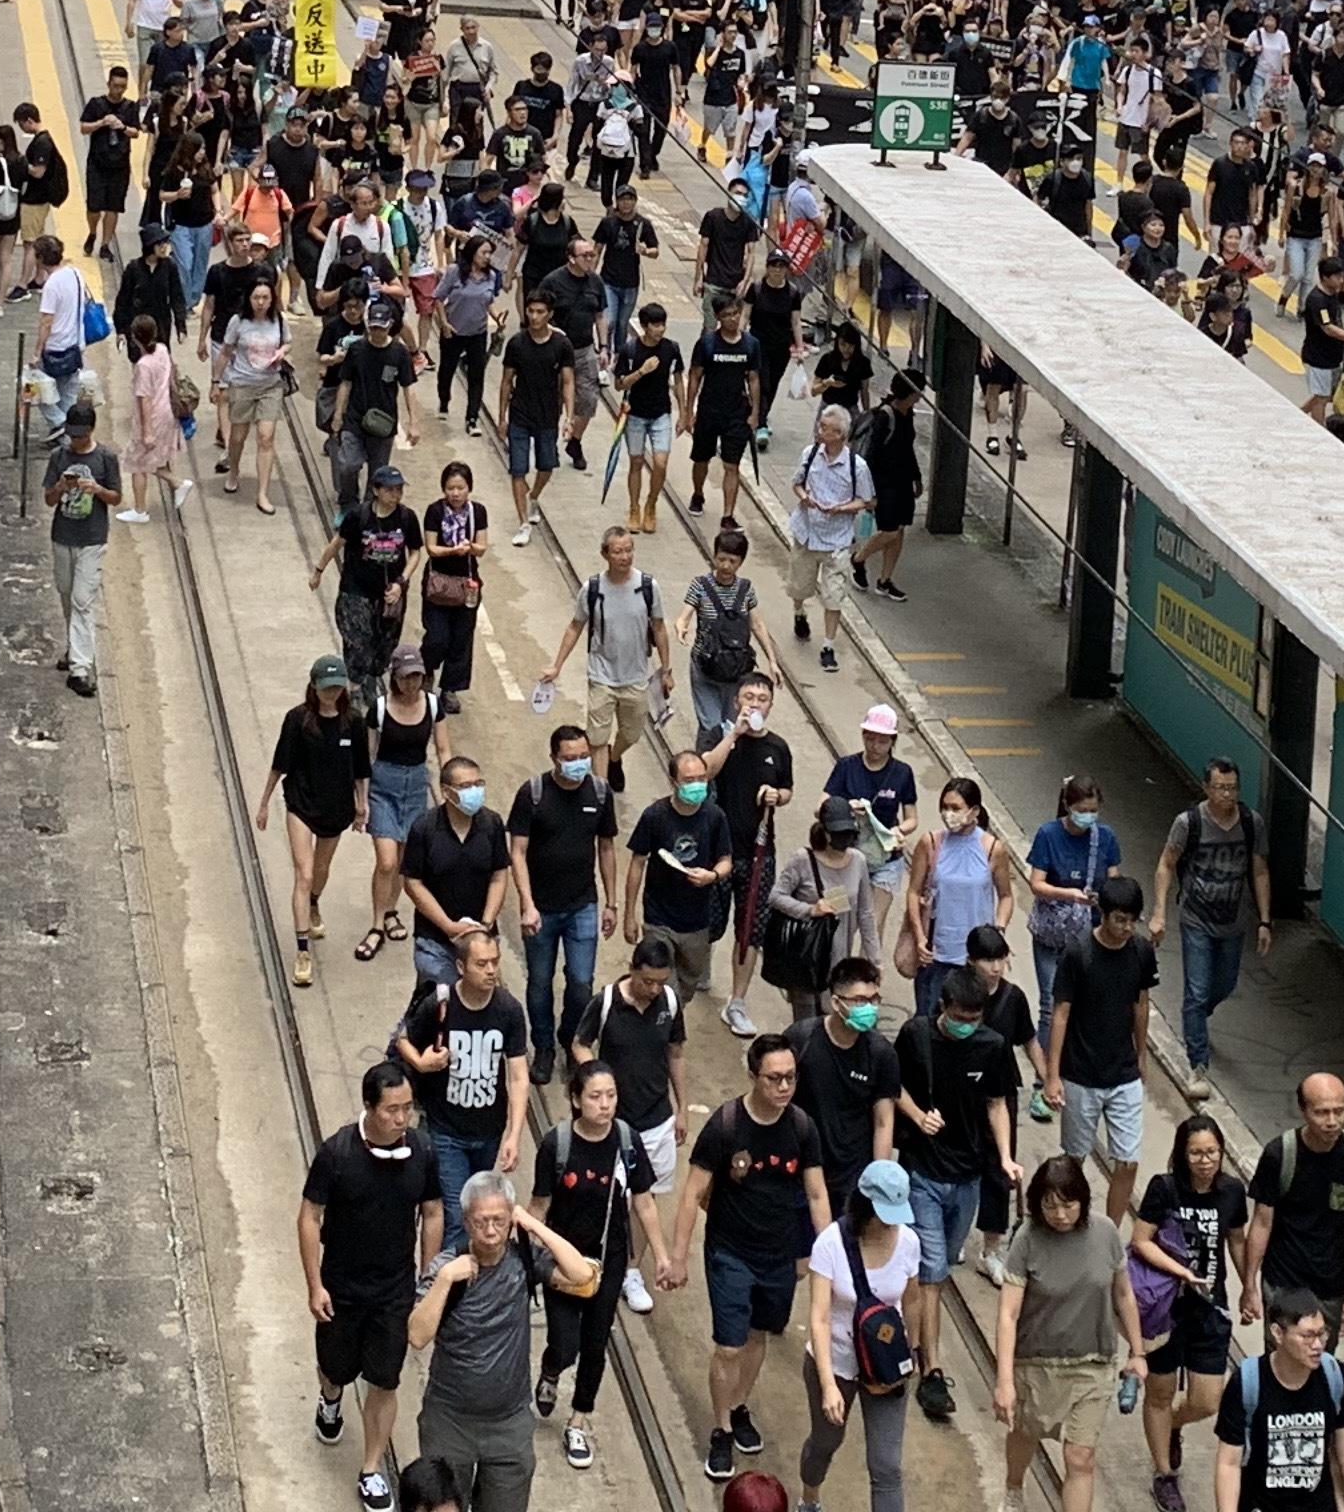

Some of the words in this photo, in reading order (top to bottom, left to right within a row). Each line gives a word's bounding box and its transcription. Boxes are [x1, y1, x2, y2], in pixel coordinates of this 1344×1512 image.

[303, 2, 329, 83] 反送中
[1160, 592, 1187, 639] TRAM
[1187, 611, 1229, 665] SHELTER
[1229, 634, 1256, 685] PLUS
[448, 1029, 504, 1080] BIG
[446, 1076, 498, 1108] BOSS
[1197, 1207, 1219, 1221] YOU
[1267, 1410, 1325, 1429] LONDON
